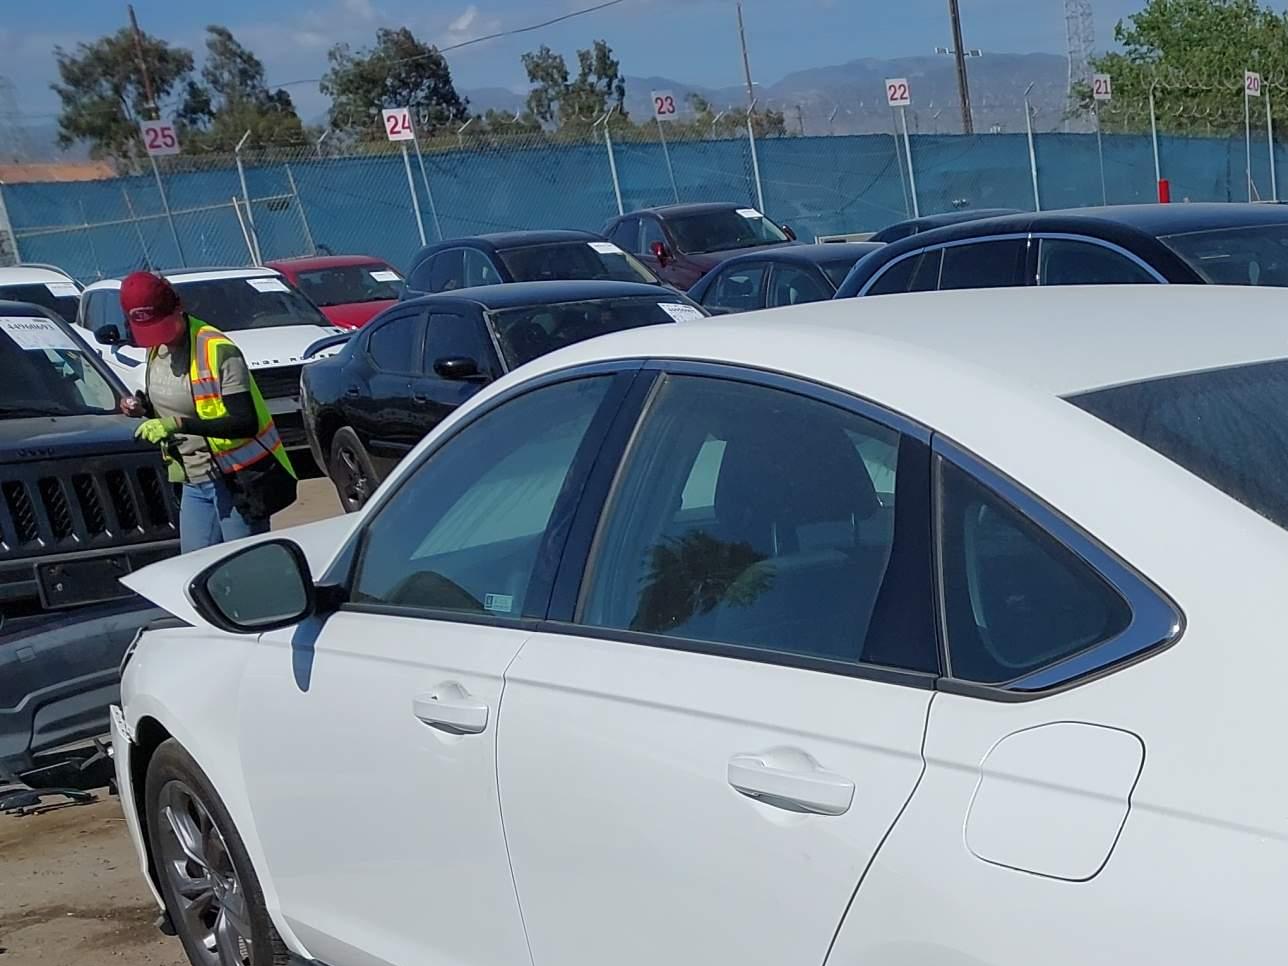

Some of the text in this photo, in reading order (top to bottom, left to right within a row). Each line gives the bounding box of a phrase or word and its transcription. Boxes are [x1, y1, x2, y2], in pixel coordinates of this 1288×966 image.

[888, 84, 908, 101] 22
[1094, 79, 1109, 95] 21
[1246, 76, 1259, 91] 20
[654, 95, 676, 115] 23
[386, 114, 413, 135] 24
[145, 127, 175, 149] 25
